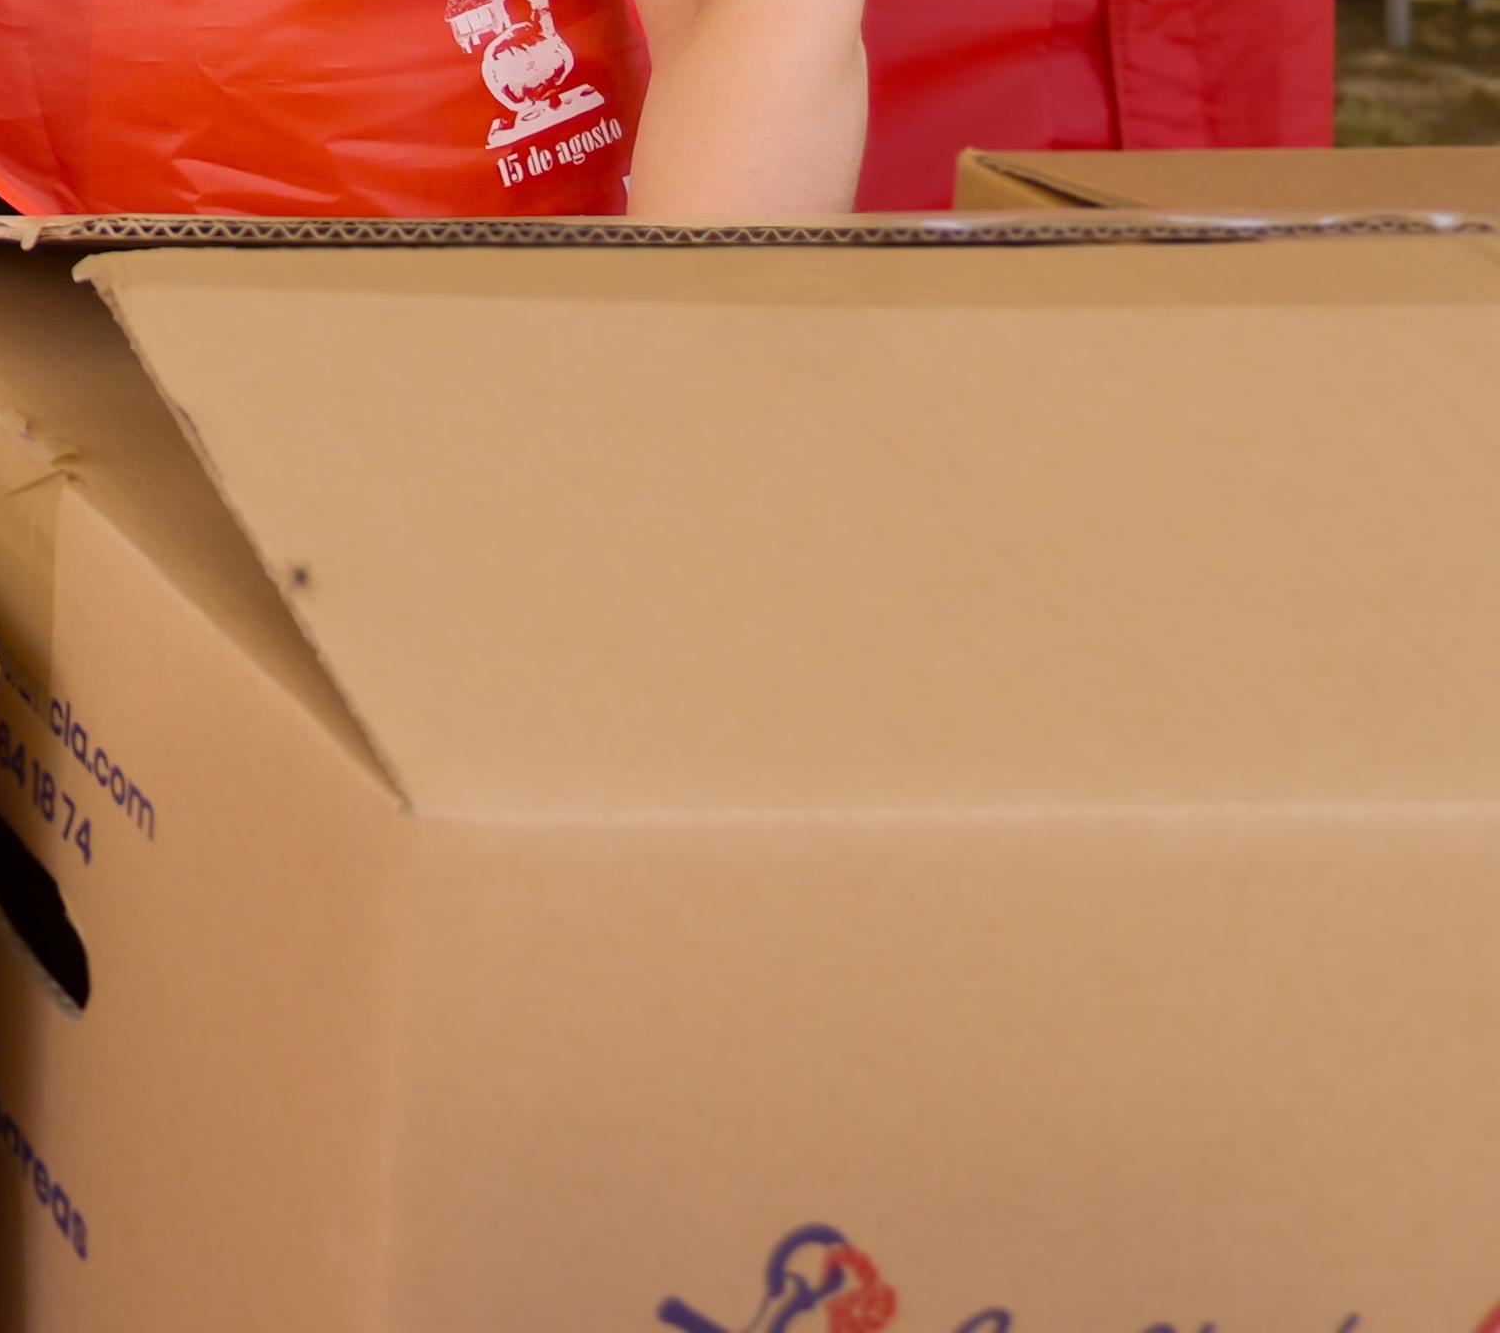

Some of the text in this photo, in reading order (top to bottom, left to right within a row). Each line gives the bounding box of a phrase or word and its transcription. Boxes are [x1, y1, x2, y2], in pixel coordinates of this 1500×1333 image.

[496, 115, 624, 189] 15 de agosto
